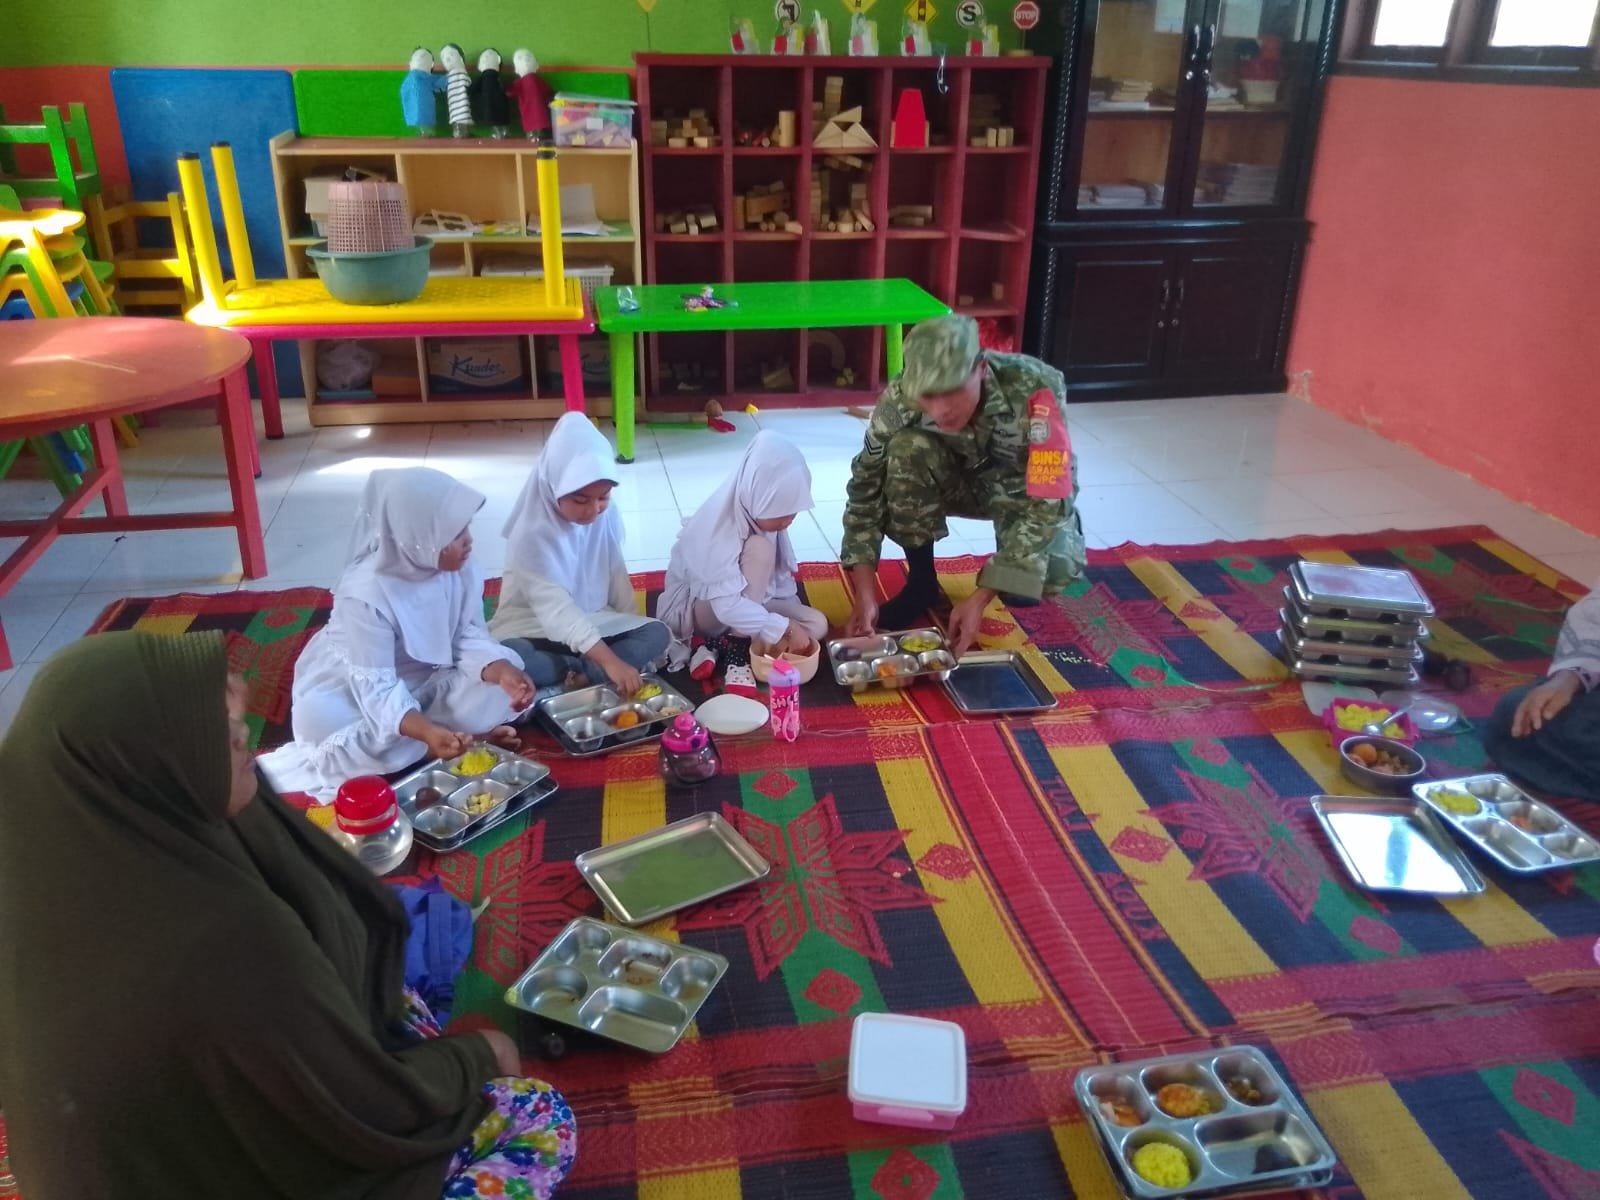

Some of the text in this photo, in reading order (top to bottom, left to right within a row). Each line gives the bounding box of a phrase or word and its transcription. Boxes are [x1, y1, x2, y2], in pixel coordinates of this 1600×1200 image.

[963, 5, 977, 22] S
[1016, 10, 1037, 20] STOP
[1030, 451, 1068, 465] BINSA
